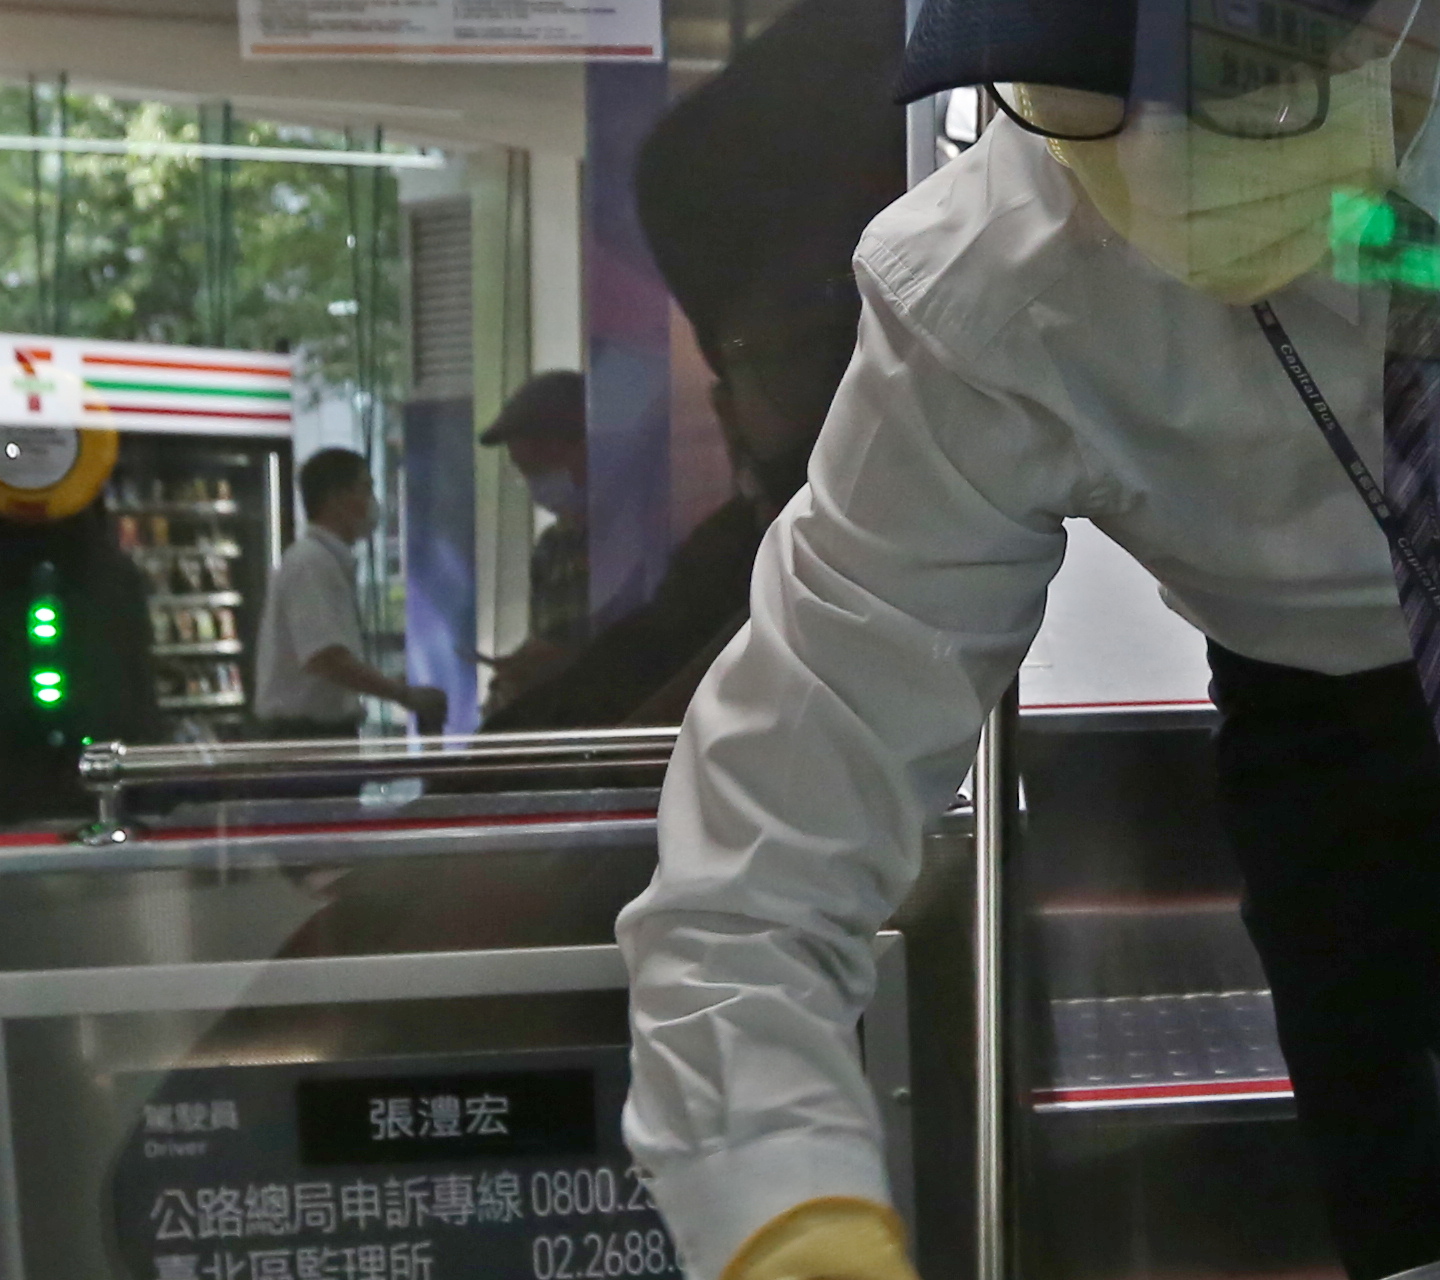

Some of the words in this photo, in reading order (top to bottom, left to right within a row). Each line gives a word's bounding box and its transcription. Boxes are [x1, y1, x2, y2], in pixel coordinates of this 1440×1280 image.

[1281, 343, 1318, 400] Capital
[1314, 401, 1335, 431] Bus
[142, 1099, 241, 1134] 駕駛員
[144, 1139, 208, 1159] Driver
[150, 1170, 523, 1241] 公路總局申訴專線
[533, 1229, 682, 1280] 02.2688.
